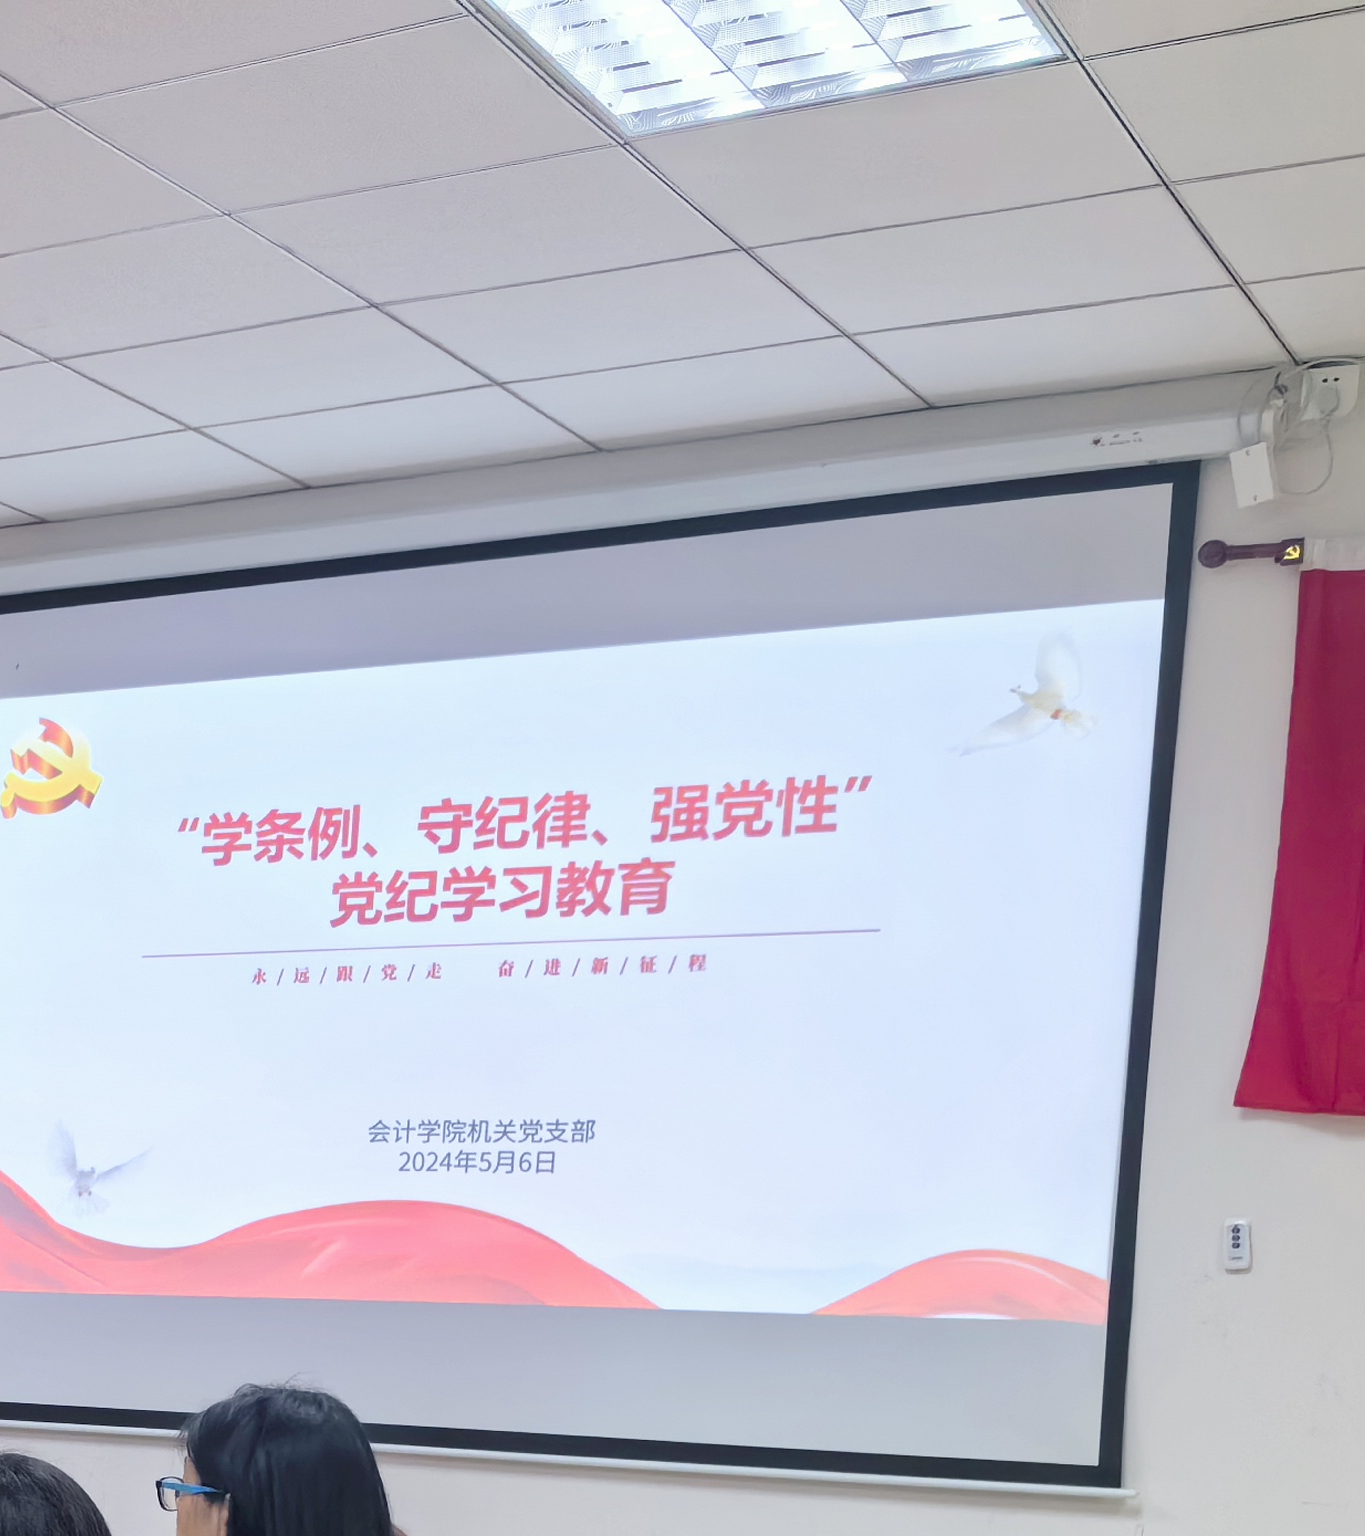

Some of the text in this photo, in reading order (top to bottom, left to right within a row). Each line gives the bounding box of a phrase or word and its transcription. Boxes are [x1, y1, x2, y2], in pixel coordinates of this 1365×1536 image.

[177, 775, 873, 866] “学条例、守纪律、强党性”
[329, 857, 676, 929] 党纪学习教育
[368, 1119, 596, 1144] 会计学院机关党支部
[397, 1149, 556, 1175] 2024年5月6日
